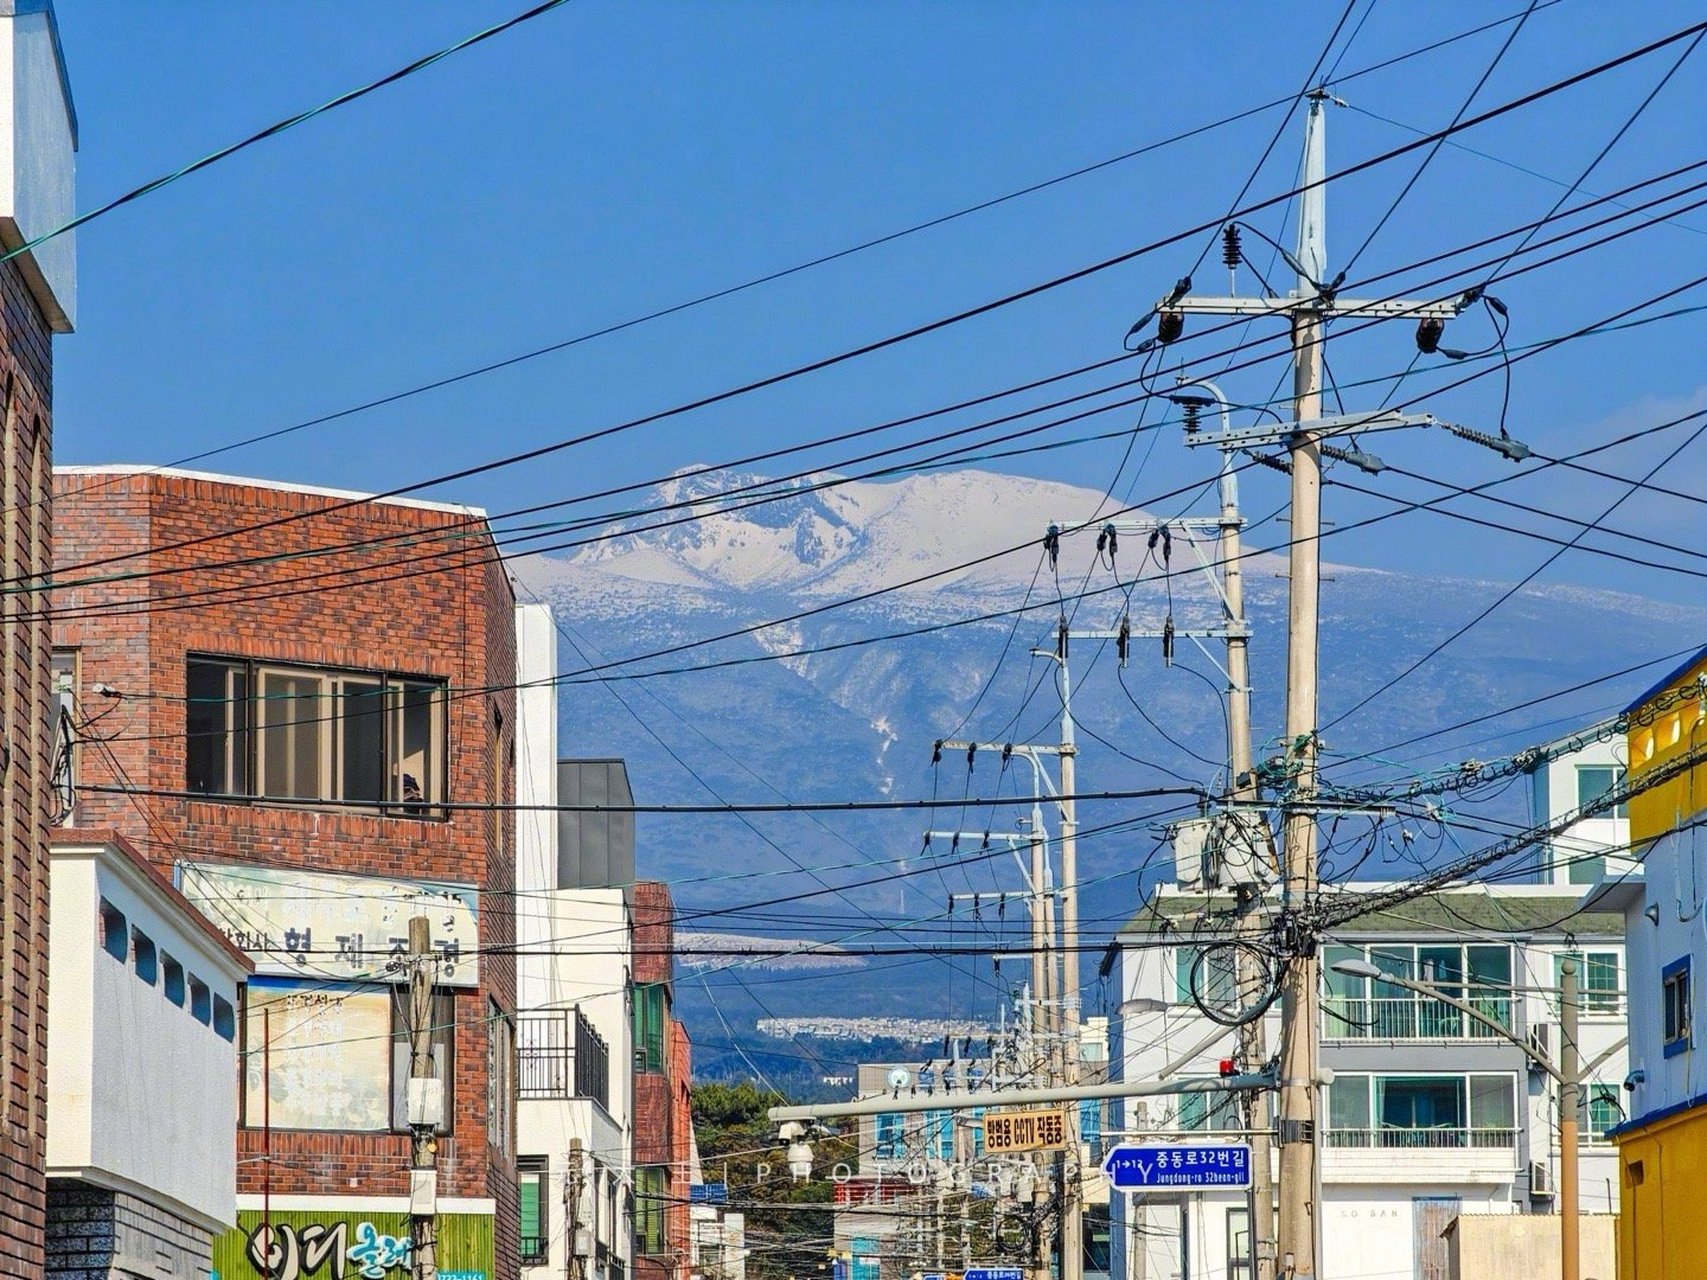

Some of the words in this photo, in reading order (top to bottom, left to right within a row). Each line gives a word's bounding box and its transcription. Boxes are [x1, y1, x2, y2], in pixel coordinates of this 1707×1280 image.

[987, 1119, 1011, 1148] 방범용
[1014, 1118, 1035, 1145] CCTV
[1037, 1115, 1062, 1144] 작동중
[1155, 1151, 1245, 1169] 중동로32번길
[1156, 1172, 1203, 1186] Jungdong-ro
[1205, 1171, 1246, 1185] 32beon-gil
